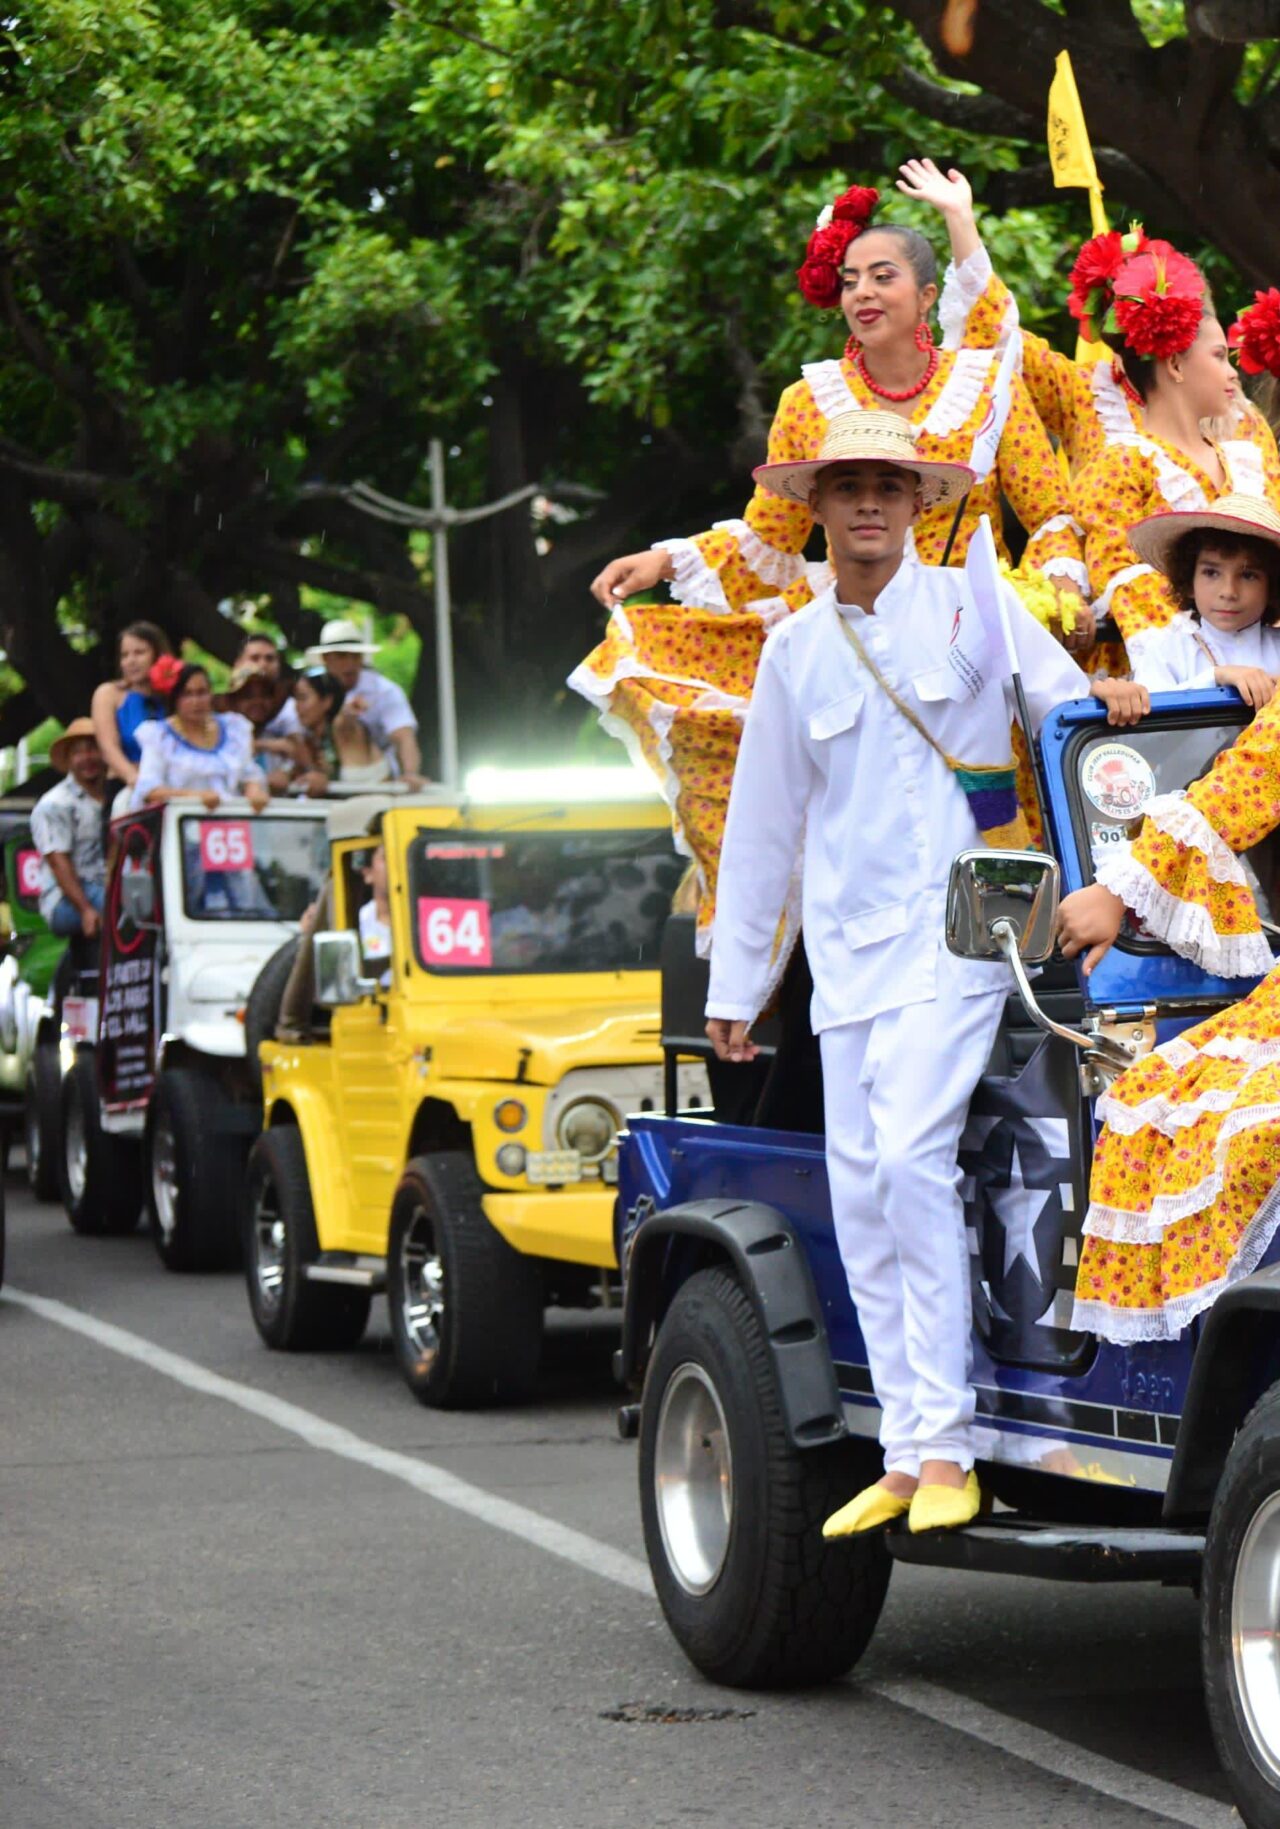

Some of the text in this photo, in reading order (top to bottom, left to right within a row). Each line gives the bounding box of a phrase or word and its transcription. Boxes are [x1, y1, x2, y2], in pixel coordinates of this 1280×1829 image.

[206, 828, 247, 864] 65
[22, 855, 42, 889] 6
[427, 907, 485, 957] 64
